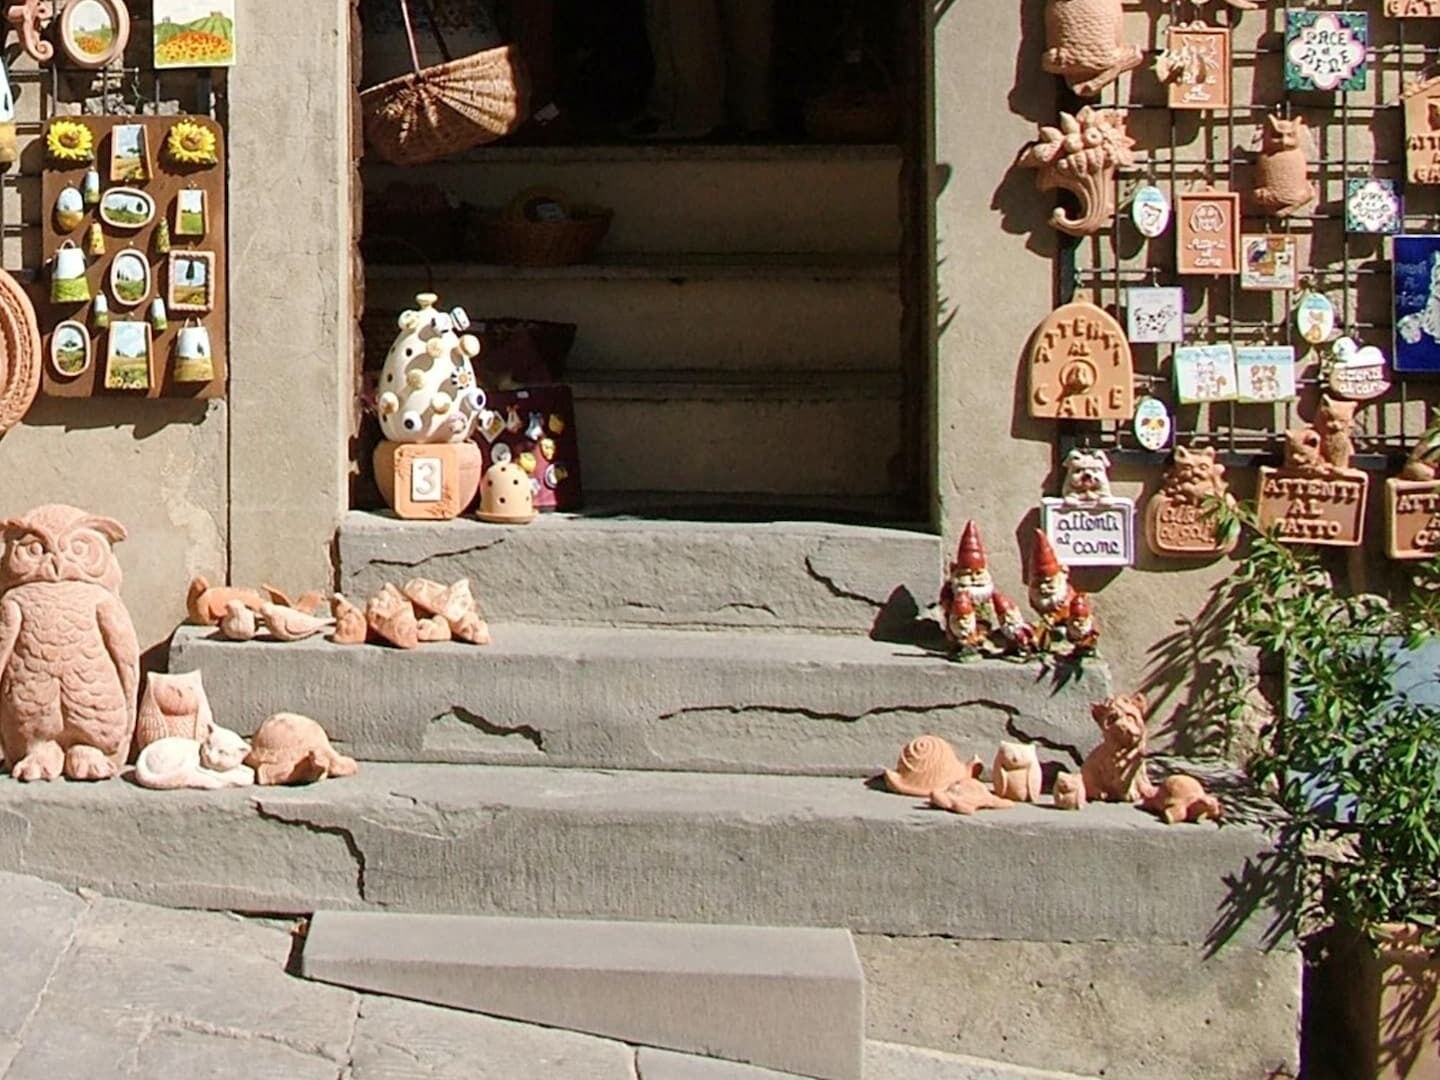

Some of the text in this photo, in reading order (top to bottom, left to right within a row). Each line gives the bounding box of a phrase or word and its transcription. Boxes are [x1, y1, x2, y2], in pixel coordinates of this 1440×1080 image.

[1304, 30, 1348, 46] PACE
[1033, 316, 1120, 367] ATTENTI
[1067, 341, 1090, 357] AL
[1033, 384, 1123, 418] CANE
[415, 462, 437, 496] 3
[1263, 478, 1360, 499] ATTENTI
[1289, 498, 1324, 515] AL
[1056, 513, 1120, 532] attenti
[1056, 532, 1071, 545] al
[1072, 541, 1121, 556] cane
